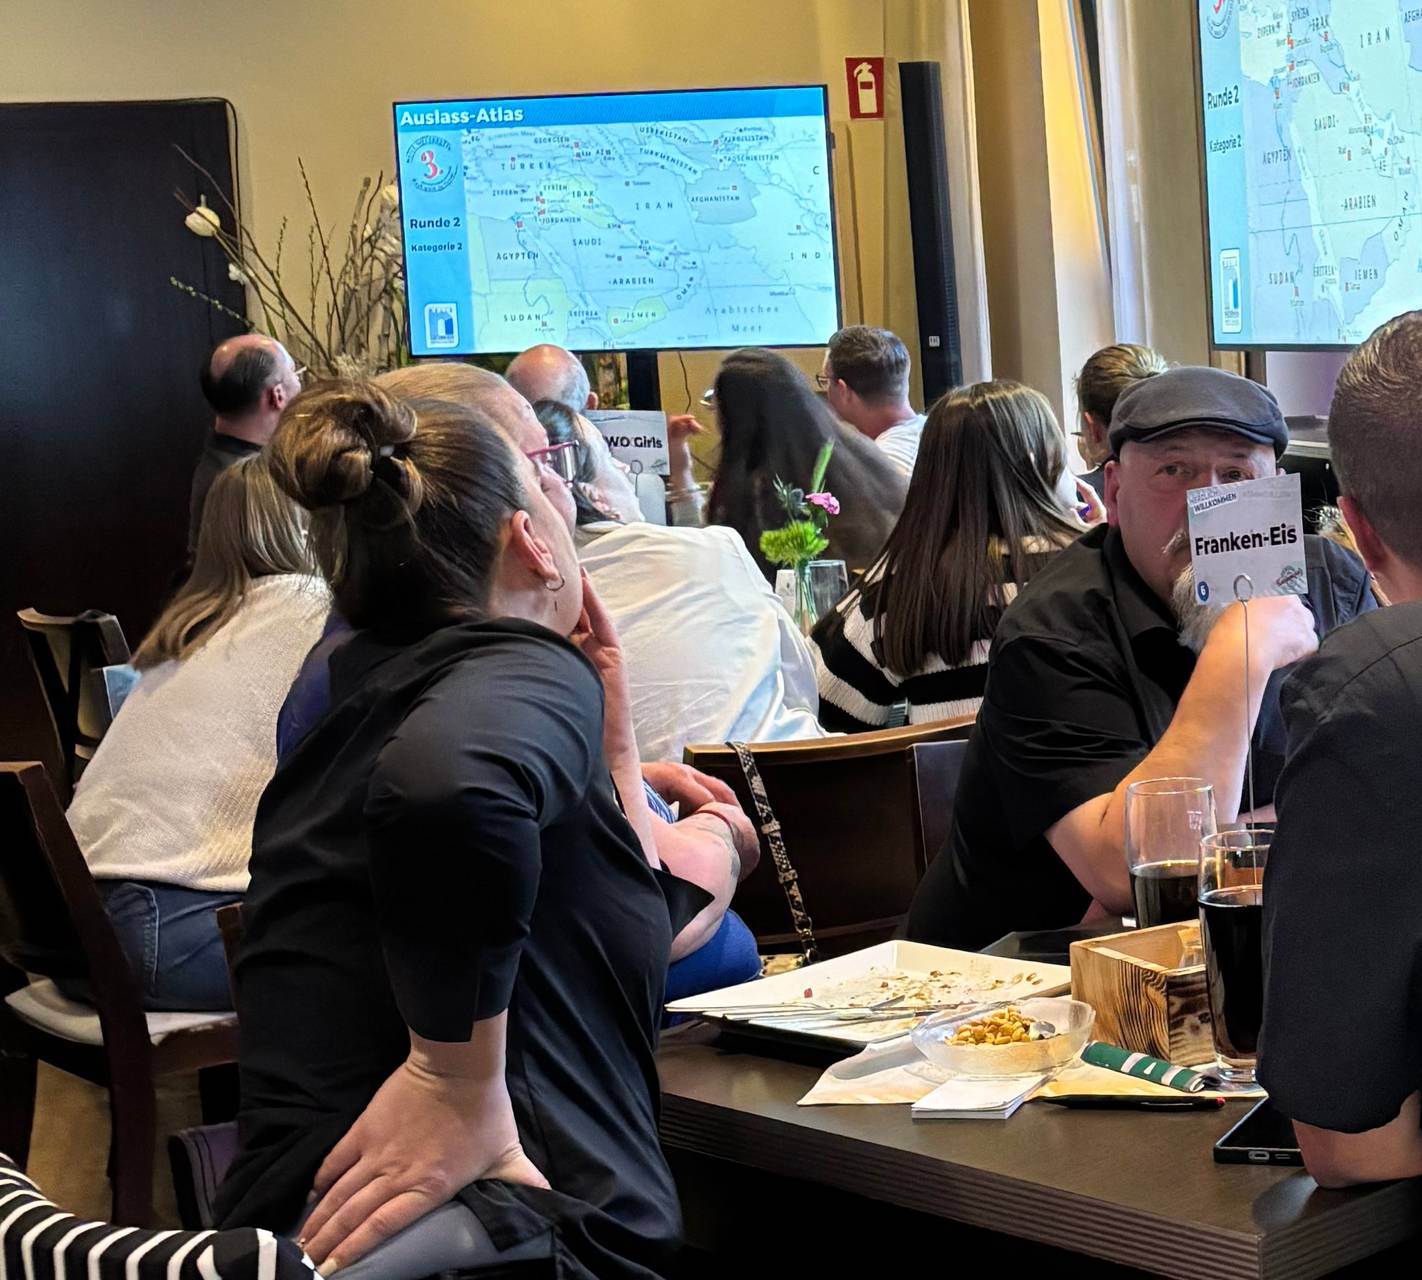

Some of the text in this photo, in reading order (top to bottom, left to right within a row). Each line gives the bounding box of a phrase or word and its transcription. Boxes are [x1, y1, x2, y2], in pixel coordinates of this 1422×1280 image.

[1360, 27, 1391, 48] IRAN
[1207, 85, 1240, 110] Runde 2
[400, 107, 524, 126] Auslass-Atlas
[1209, 134, 1242, 155] Kategorie 2
[635, 202, 673, 210] IRAN
[690, 195, 740, 203] AFGHANISTAN
[410, 217, 461, 229] Runde 2
[411, 242, 455, 253] Kategorie
[1268, 271, 1295, 286] SUDAN
[503, 313, 541, 322] SUDAN
[604, 435, 663, 448] WO Girls
[1193, 492, 1237, 512] WILLKOMMEN
[1195, 523, 1298, 556] Franken-Eis
